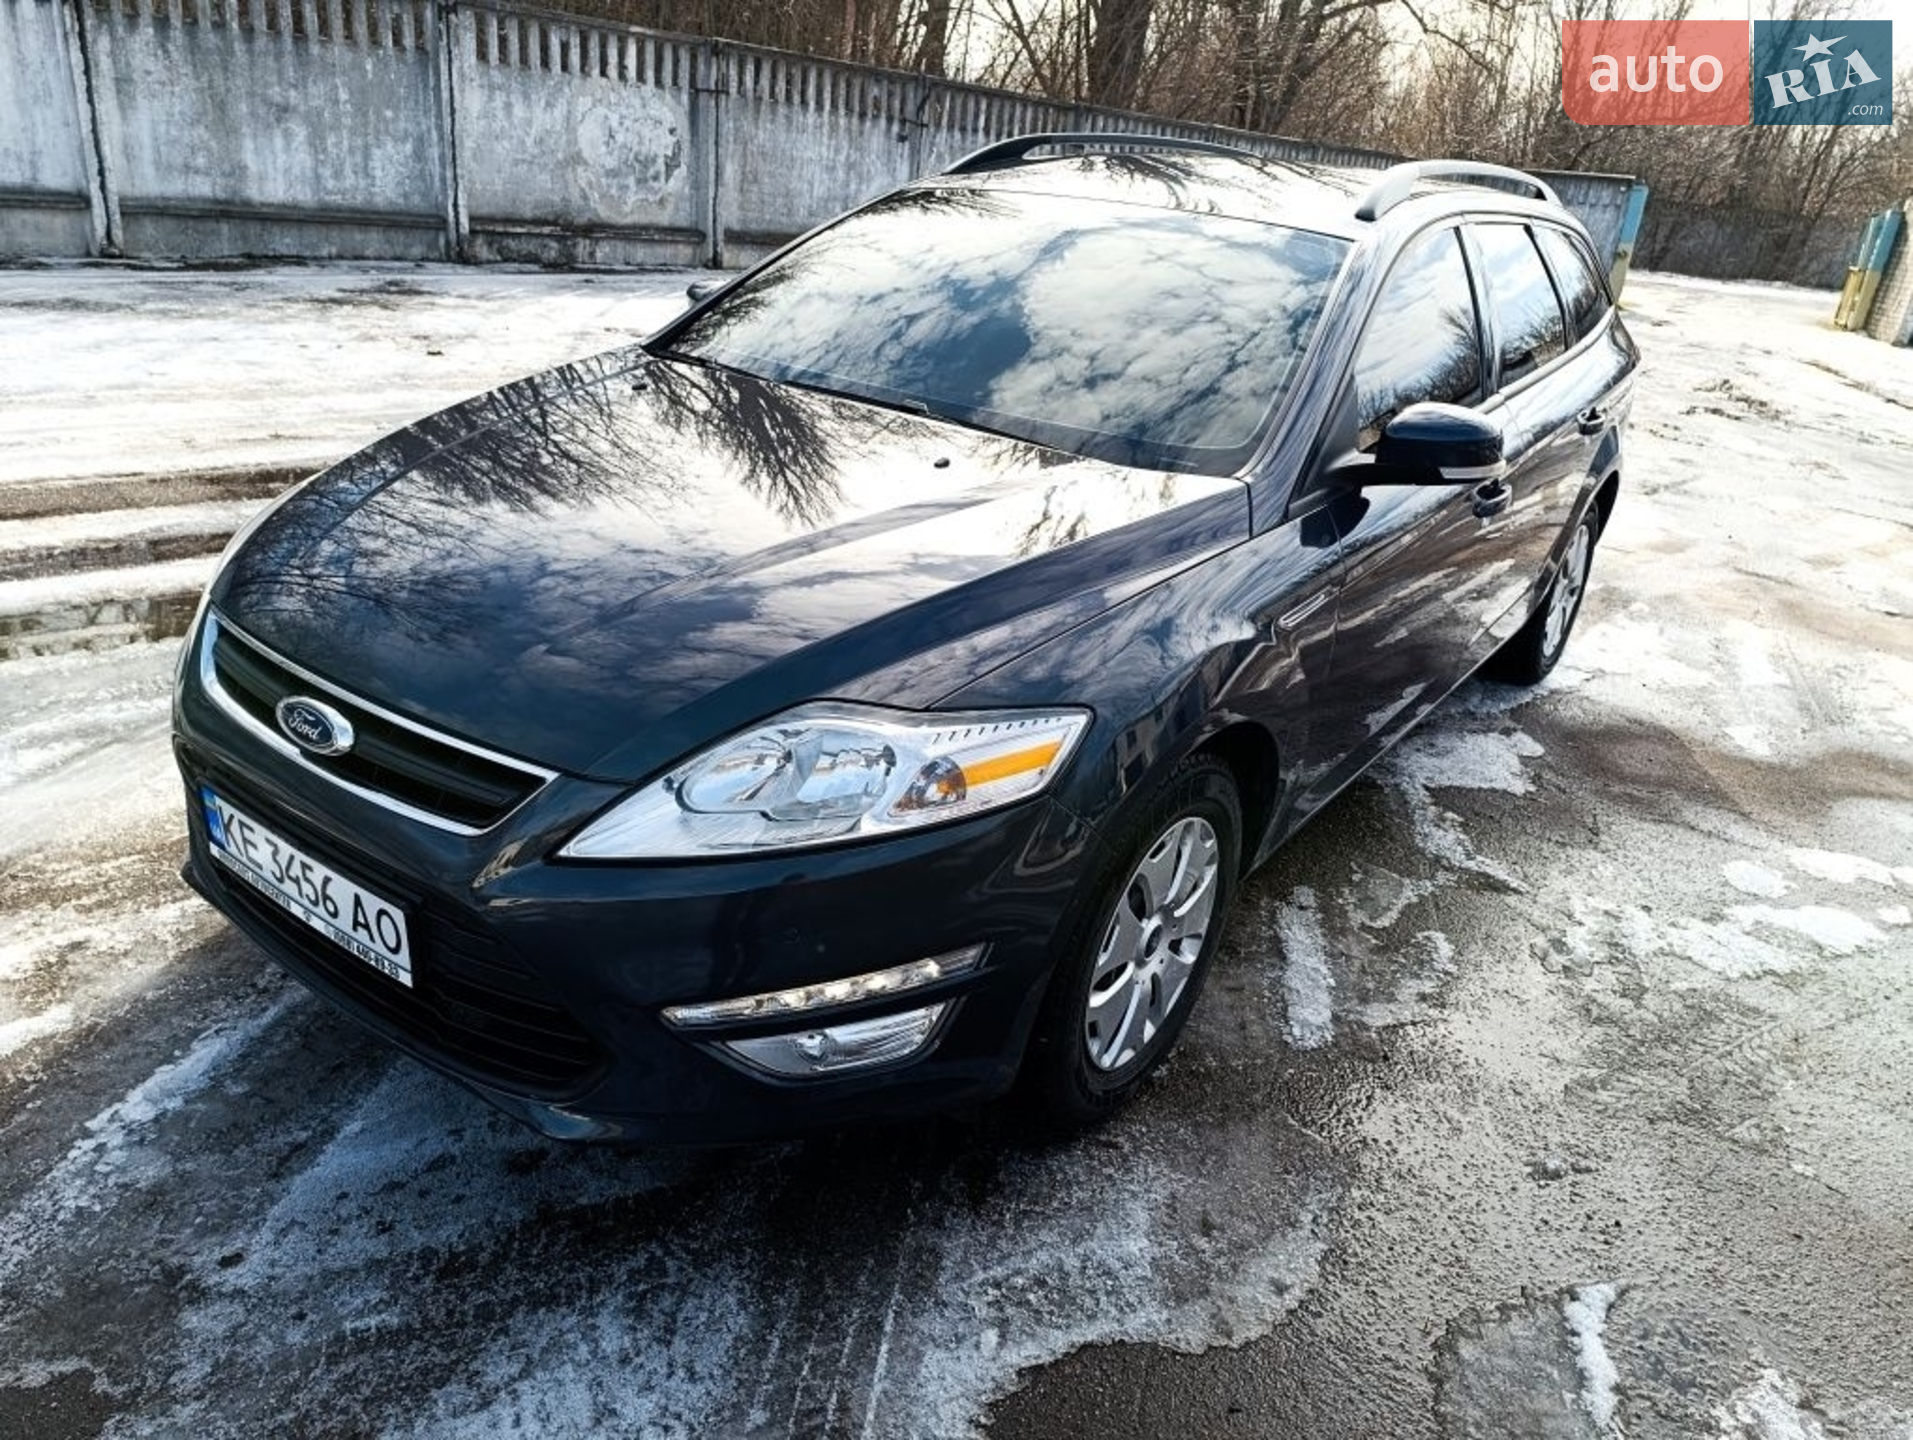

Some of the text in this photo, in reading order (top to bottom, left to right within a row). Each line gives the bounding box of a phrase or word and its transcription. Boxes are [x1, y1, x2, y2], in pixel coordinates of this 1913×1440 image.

[288, 708, 323, 740] Ford
[219, 805, 263, 872] KE
[265, 838, 339, 919] 3456
[352, 892, 402, 955] AO
